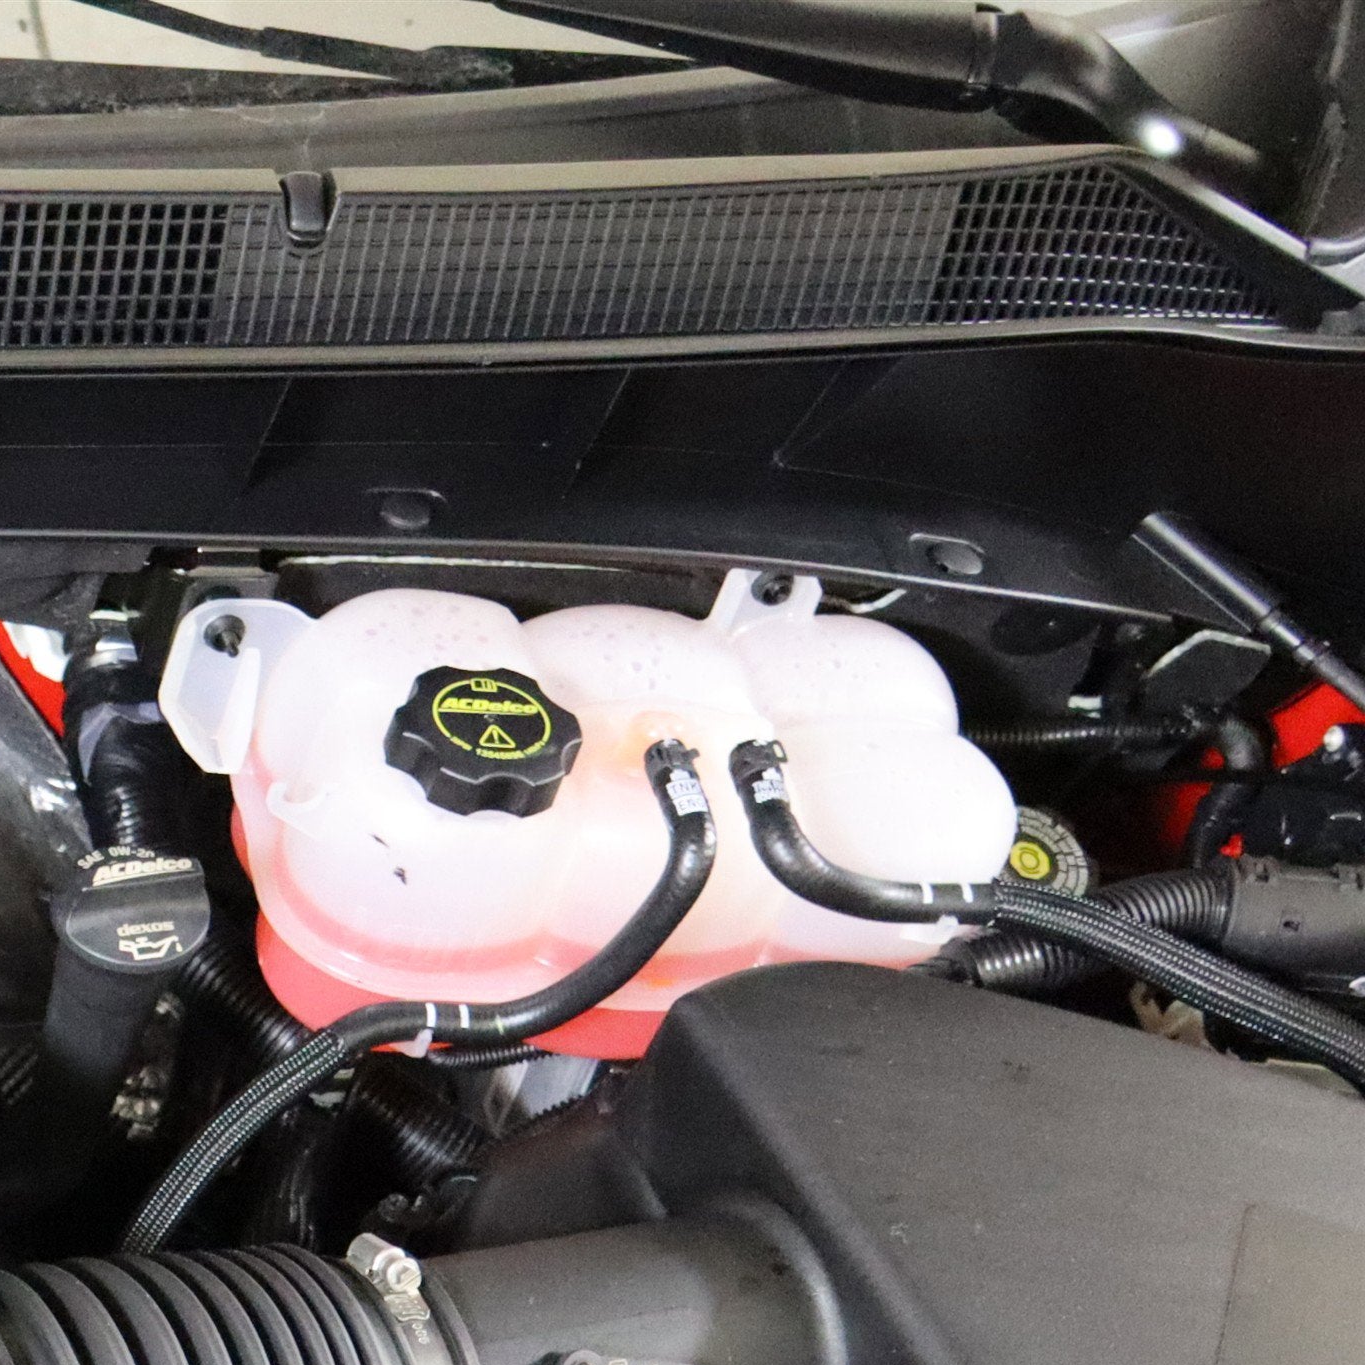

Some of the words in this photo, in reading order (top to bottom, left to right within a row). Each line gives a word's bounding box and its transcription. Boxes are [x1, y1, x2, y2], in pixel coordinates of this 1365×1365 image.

[439, 696, 538, 715] ACDelco
[77, 849, 105, 869] SAE
[92, 857, 193, 884] ACDelco
[116, 921, 175, 937] dexos
